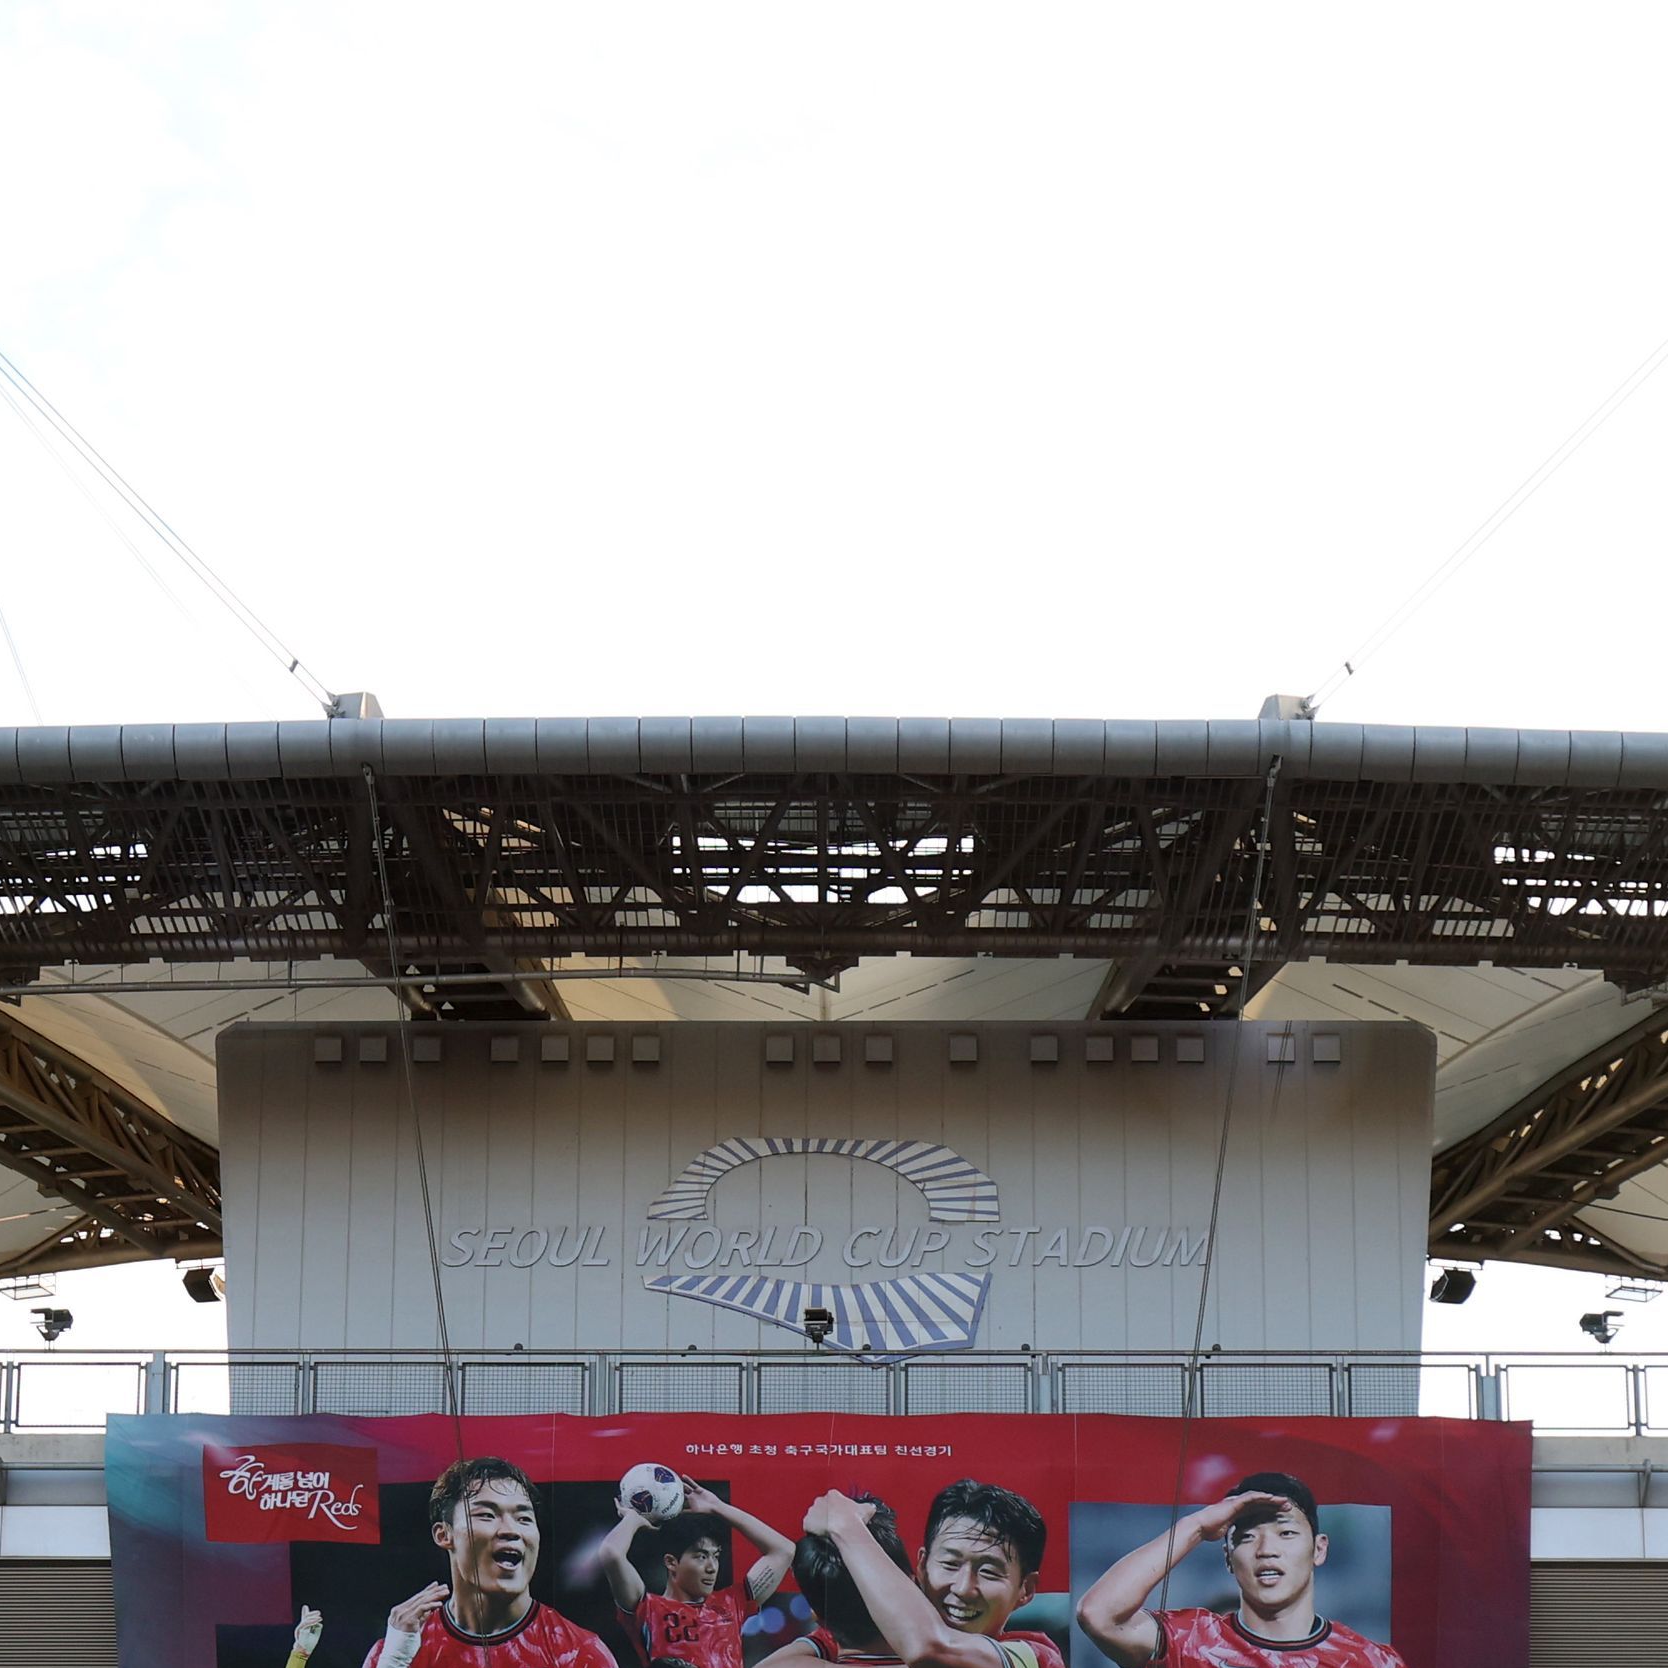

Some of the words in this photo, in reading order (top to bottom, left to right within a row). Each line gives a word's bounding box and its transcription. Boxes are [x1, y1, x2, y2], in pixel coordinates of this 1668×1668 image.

[442, 1225, 611, 1268] SEOUL
[634, 1225, 825, 1268] WORLD
[842, 1225, 954, 1268] CUP
[973, 1225, 1214, 1269] STADIUM
[685, 1443, 743, 1455] 하나은행
[748, 1444, 778, 1456] 초청
[784, 1444, 888, 1457] 축구국가대표팀
[894, 1445, 953, 1457] 친선경기
[297, 1471, 330, 1490] 넘어
[308, 1484, 364, 1530] Reds
